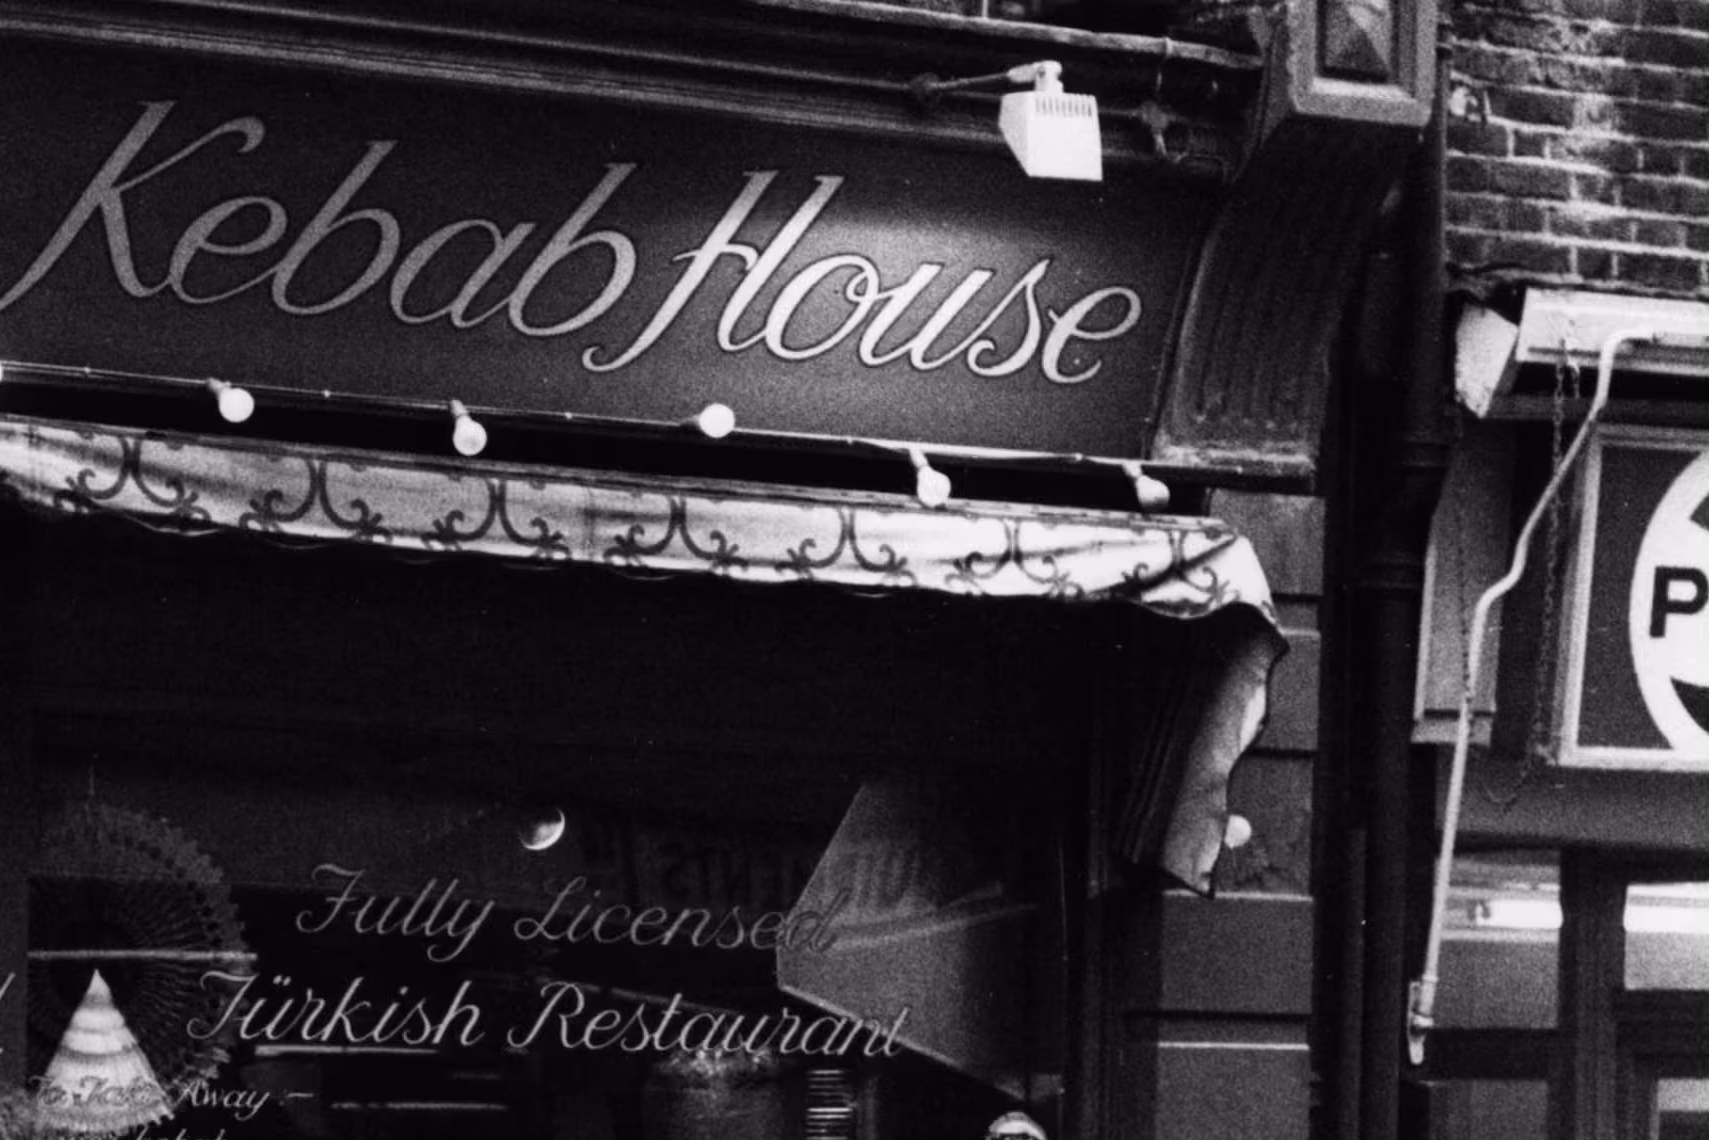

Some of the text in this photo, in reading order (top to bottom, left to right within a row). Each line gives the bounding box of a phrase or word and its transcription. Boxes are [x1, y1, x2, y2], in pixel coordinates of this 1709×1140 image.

[581, 169, 1141, 385] House
[296, 863, 849, 963] Fully Licensed
[186, 969, 911, 1058] Türkish Restaurant
[174, 1078, 271, 1122] Away
